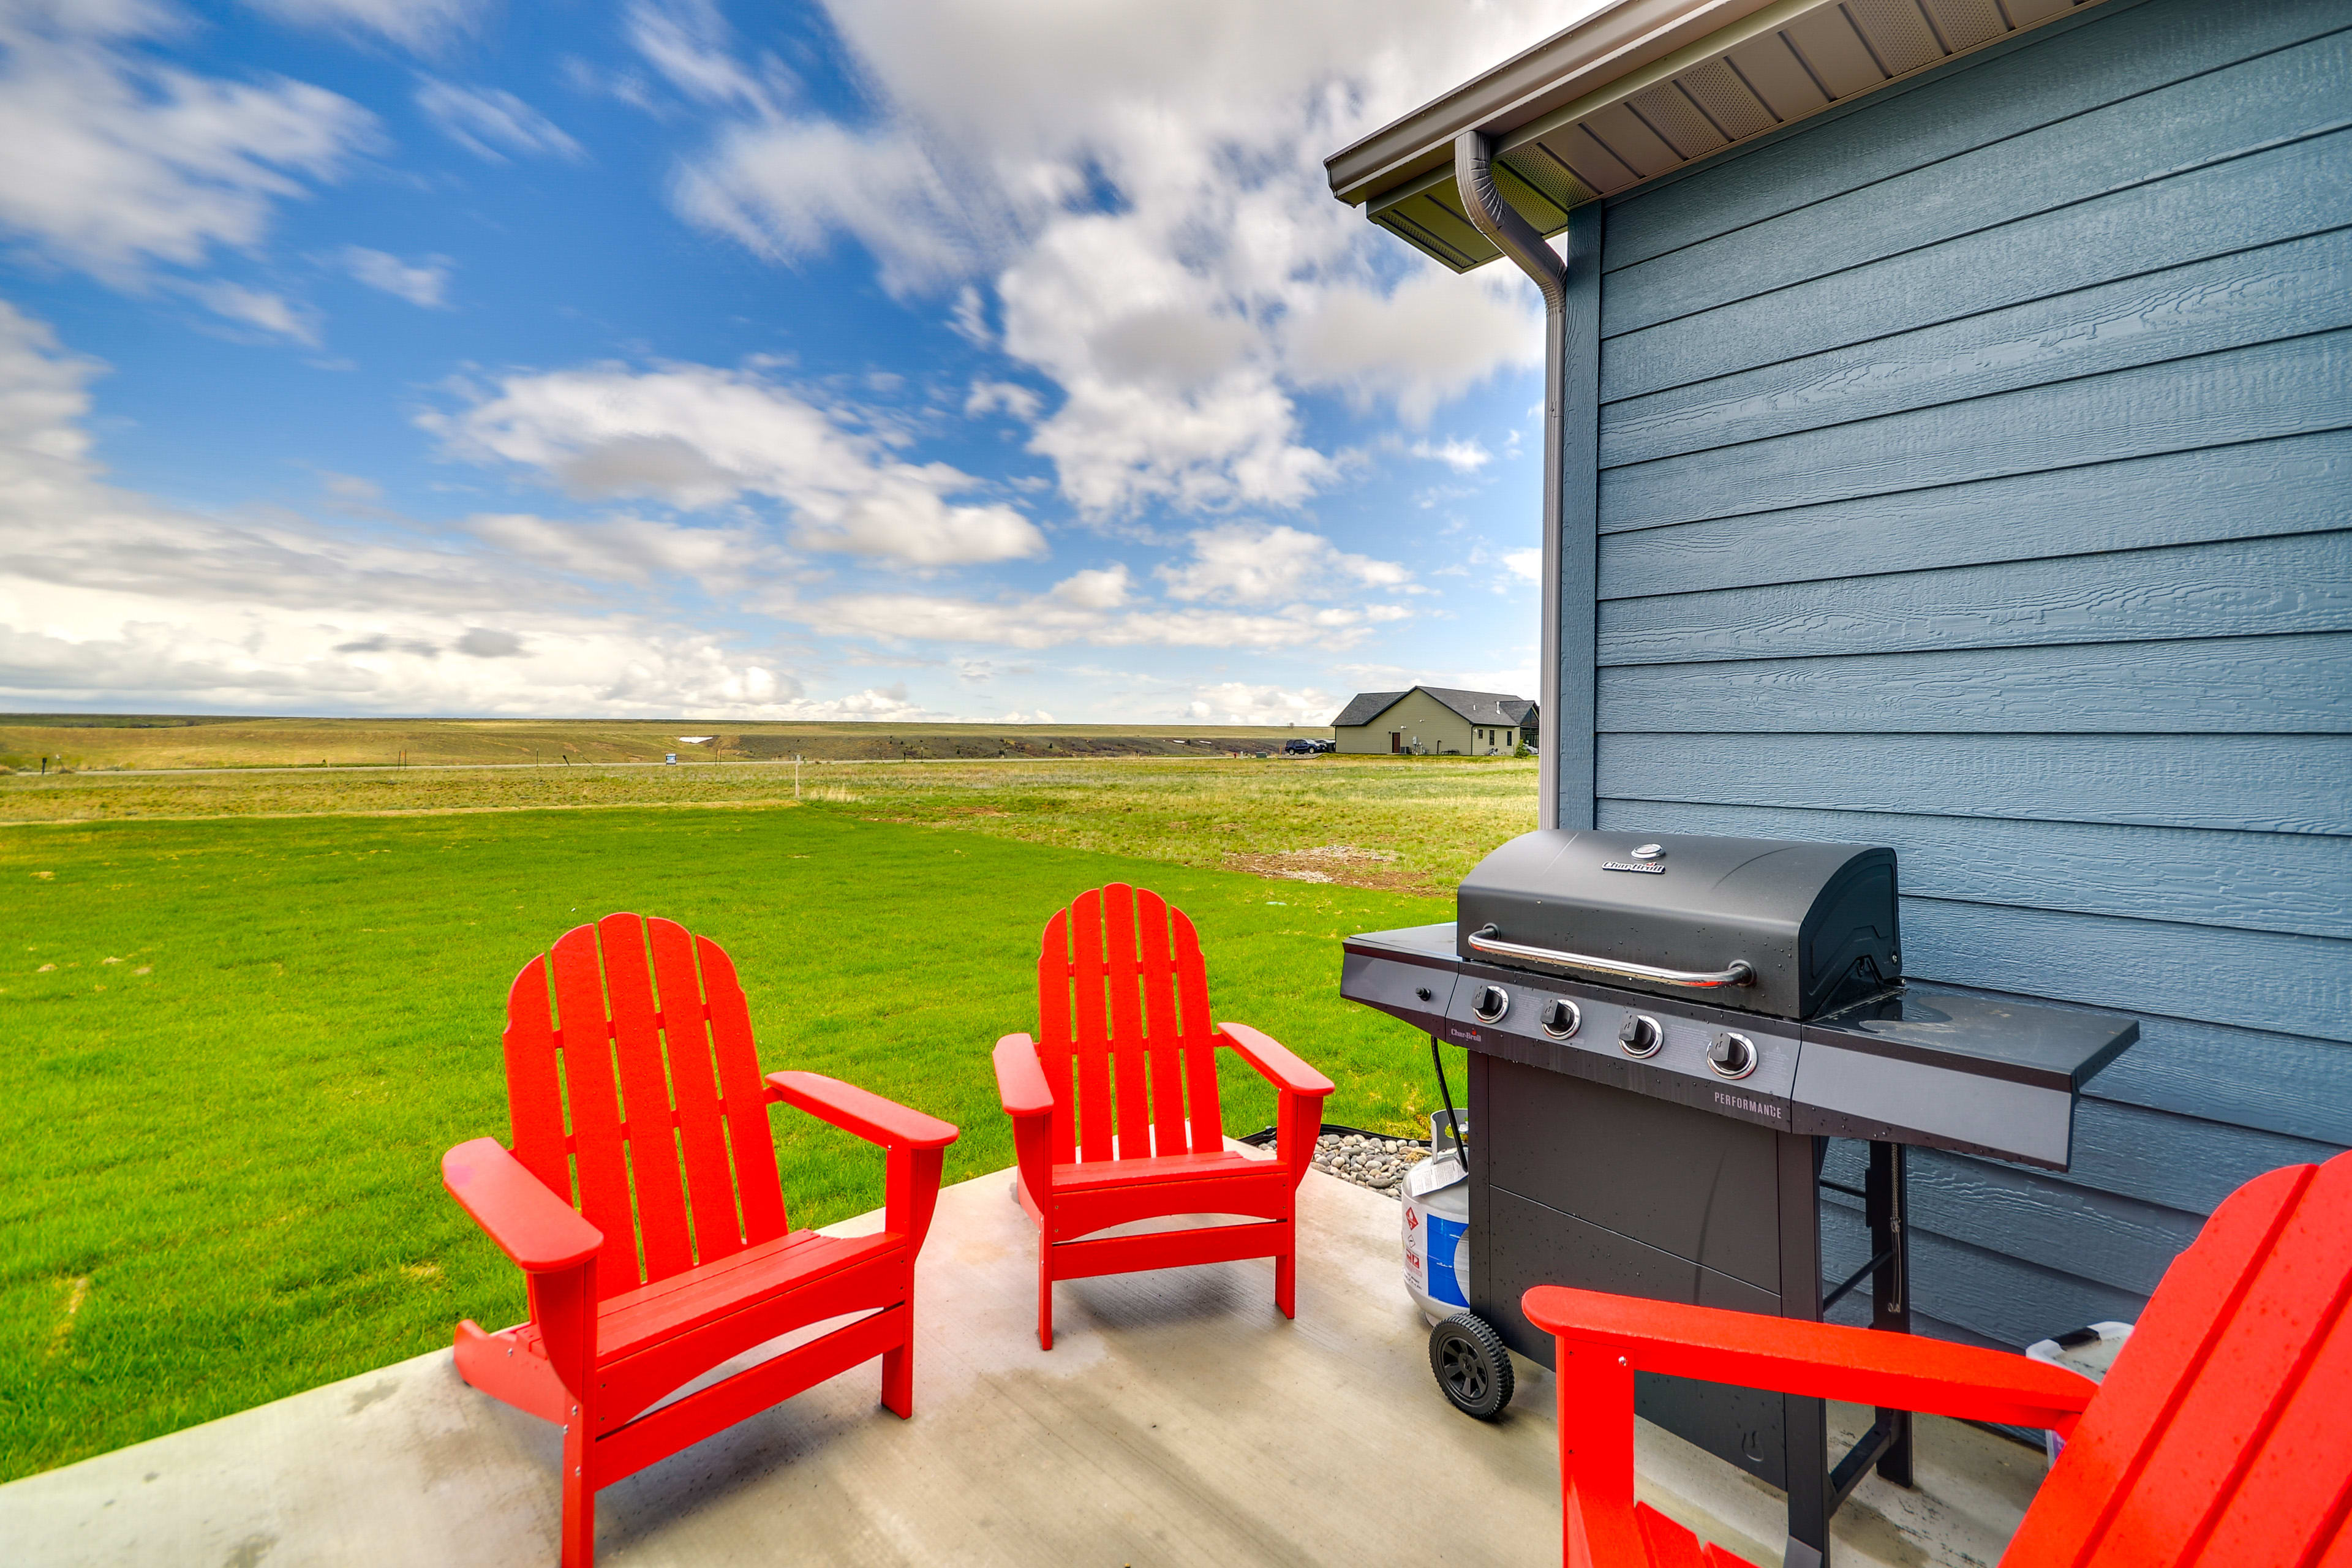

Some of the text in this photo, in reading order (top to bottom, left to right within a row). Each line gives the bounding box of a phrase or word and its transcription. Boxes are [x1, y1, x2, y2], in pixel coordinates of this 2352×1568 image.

[1602, 861, 1665, 873] Char-Broil
[1451, 1028, 1482, 1042] Char-Broil
[1714, 1092, 1782, 1119] PERFORMANCE
